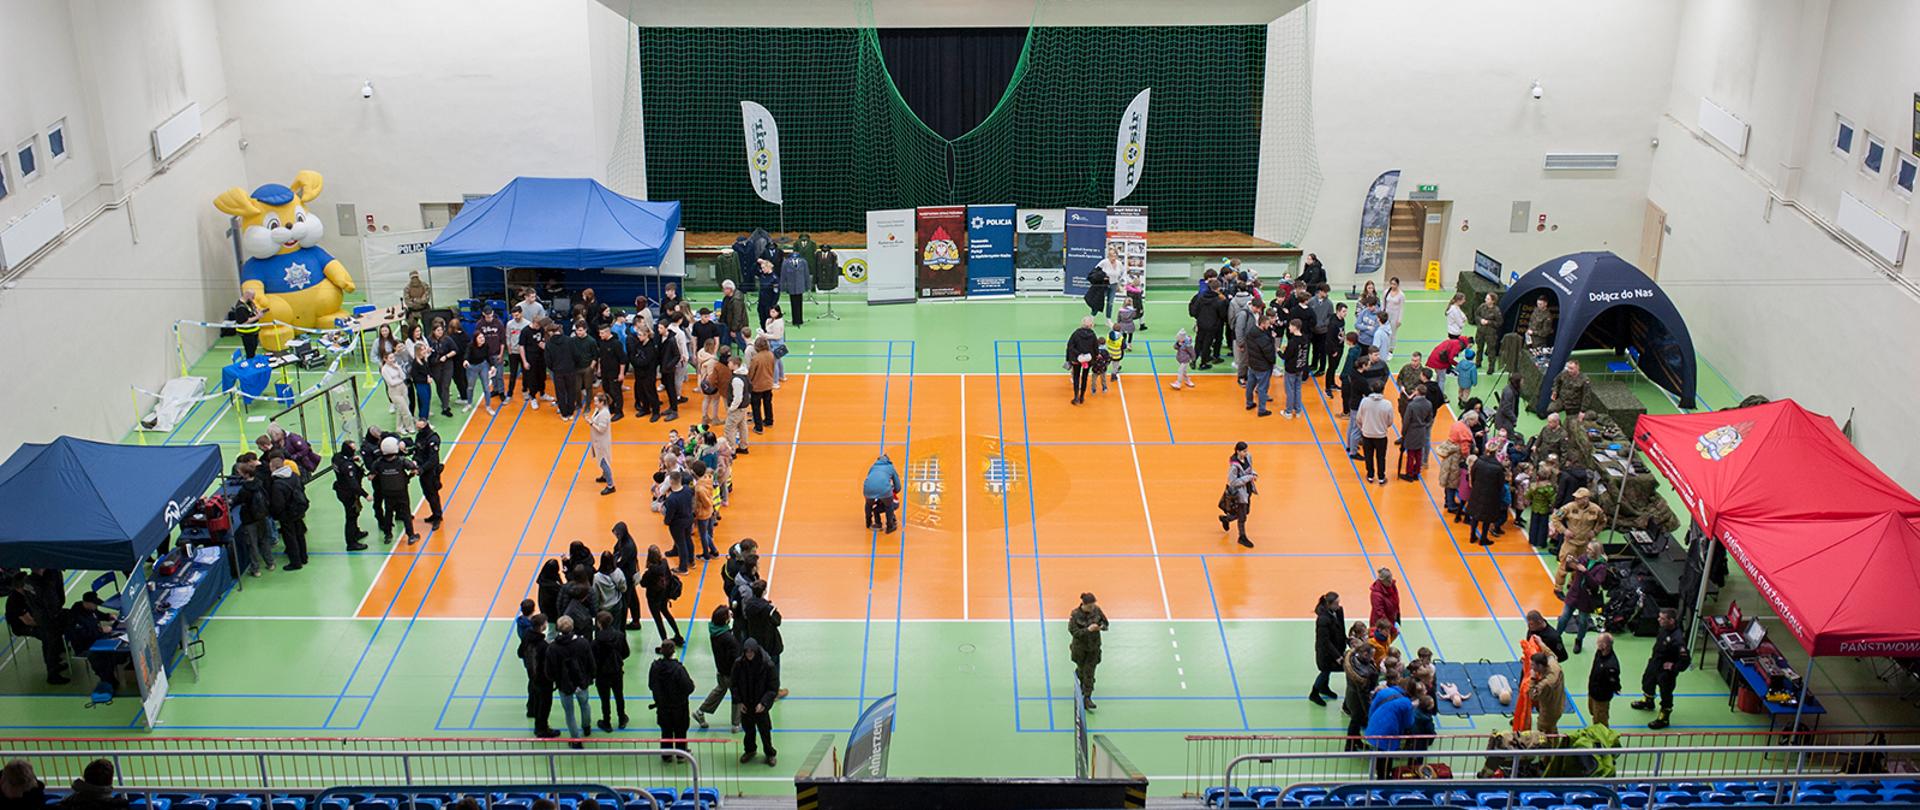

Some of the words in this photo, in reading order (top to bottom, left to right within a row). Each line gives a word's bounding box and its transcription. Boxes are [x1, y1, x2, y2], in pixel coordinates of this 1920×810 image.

[1589, 291, 1619, 303] Dołącz
[1621, 289, 1633, 299] do
[1635, 288, 1654, 298] Nas
[1723, 531, 1758, 581] PAŃSTWOWA
[1757, 574, 1777, 602] STRAŻ
[868, 716, 883, 776] ołnierzem
